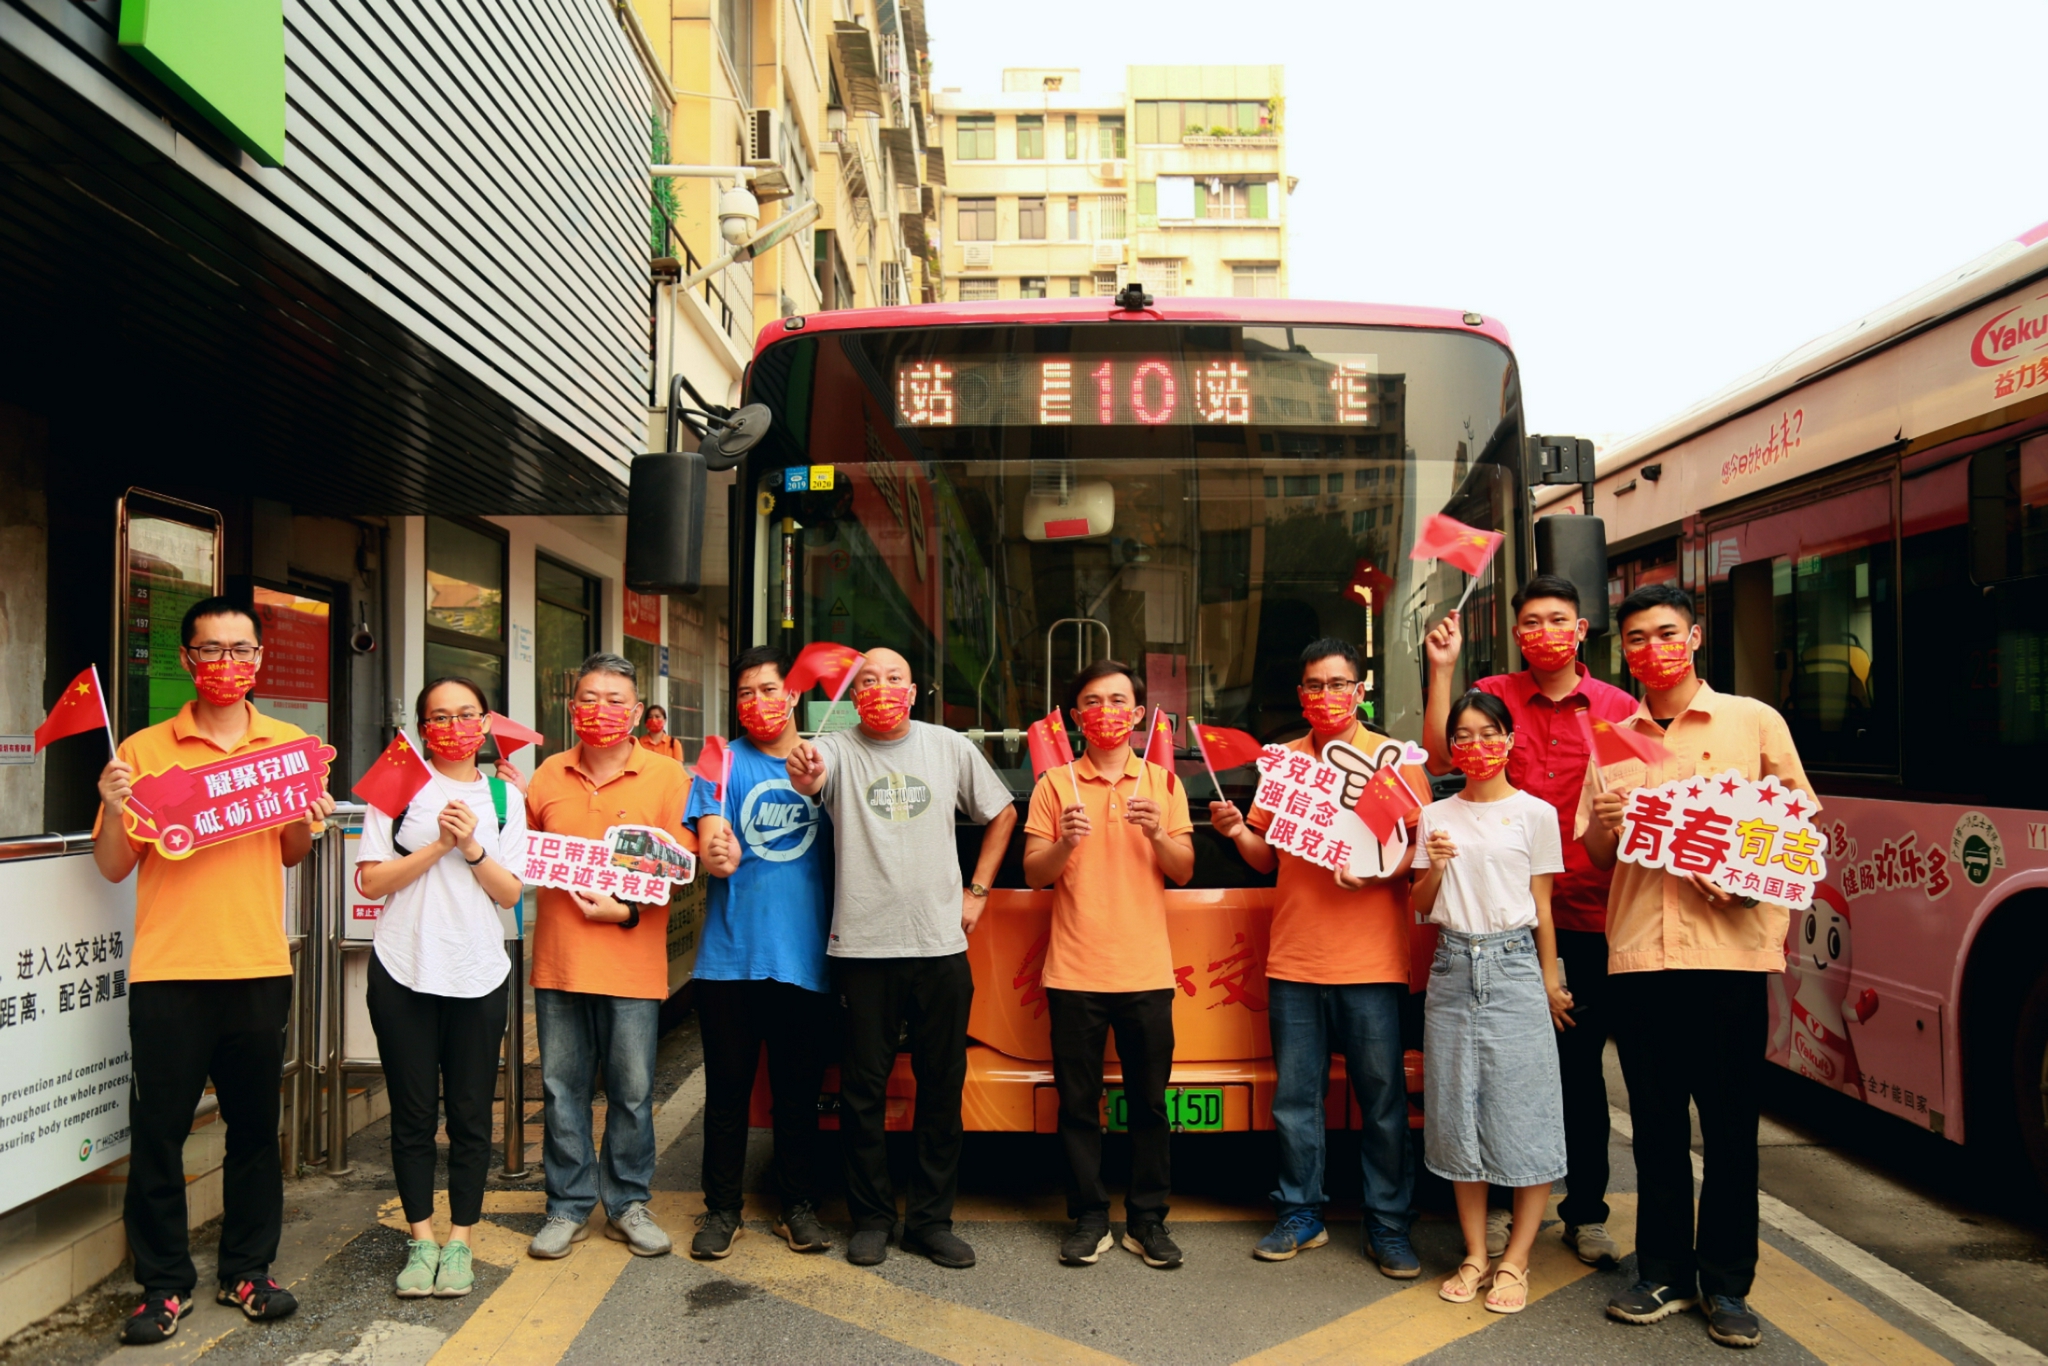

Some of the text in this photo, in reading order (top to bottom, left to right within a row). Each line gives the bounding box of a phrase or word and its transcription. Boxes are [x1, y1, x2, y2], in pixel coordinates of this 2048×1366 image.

[1092, 362, 1175, 424] 10
[137, 588, 148, 599] 25
[136, 618, 149, 629] 197
[135, 648, 148, 659] 299
[203, 750, 311, 799] 凝聚党心
[1259, 746, 1338, 795] 学党史
[192, 782, 310, 836] 砥砺前行
[755, 802, 804, 828] NIKE
[1259, 778, 1339, 829] 强信念
[1269, 816, 1353, 870] 跟党走
[1623, 794, 1820, 877] 青春有志
[525, 857, 667, 901] 游史迹学党史
[1722, 866, 1806, 902] 不负国家
[1799, 1038, 1829, 1076] Yakult
[1, 1077, 55, 1107] prevention
[56, 1068, 73, 1085] and
[75, 1057, 107, 1079] control
[53, 1094, 68, 1109] the
[70, 1083, 97, 1103] whole
[38, 1119, 62, 1138] body
[63, 1098, 120, 1128] temperature.
